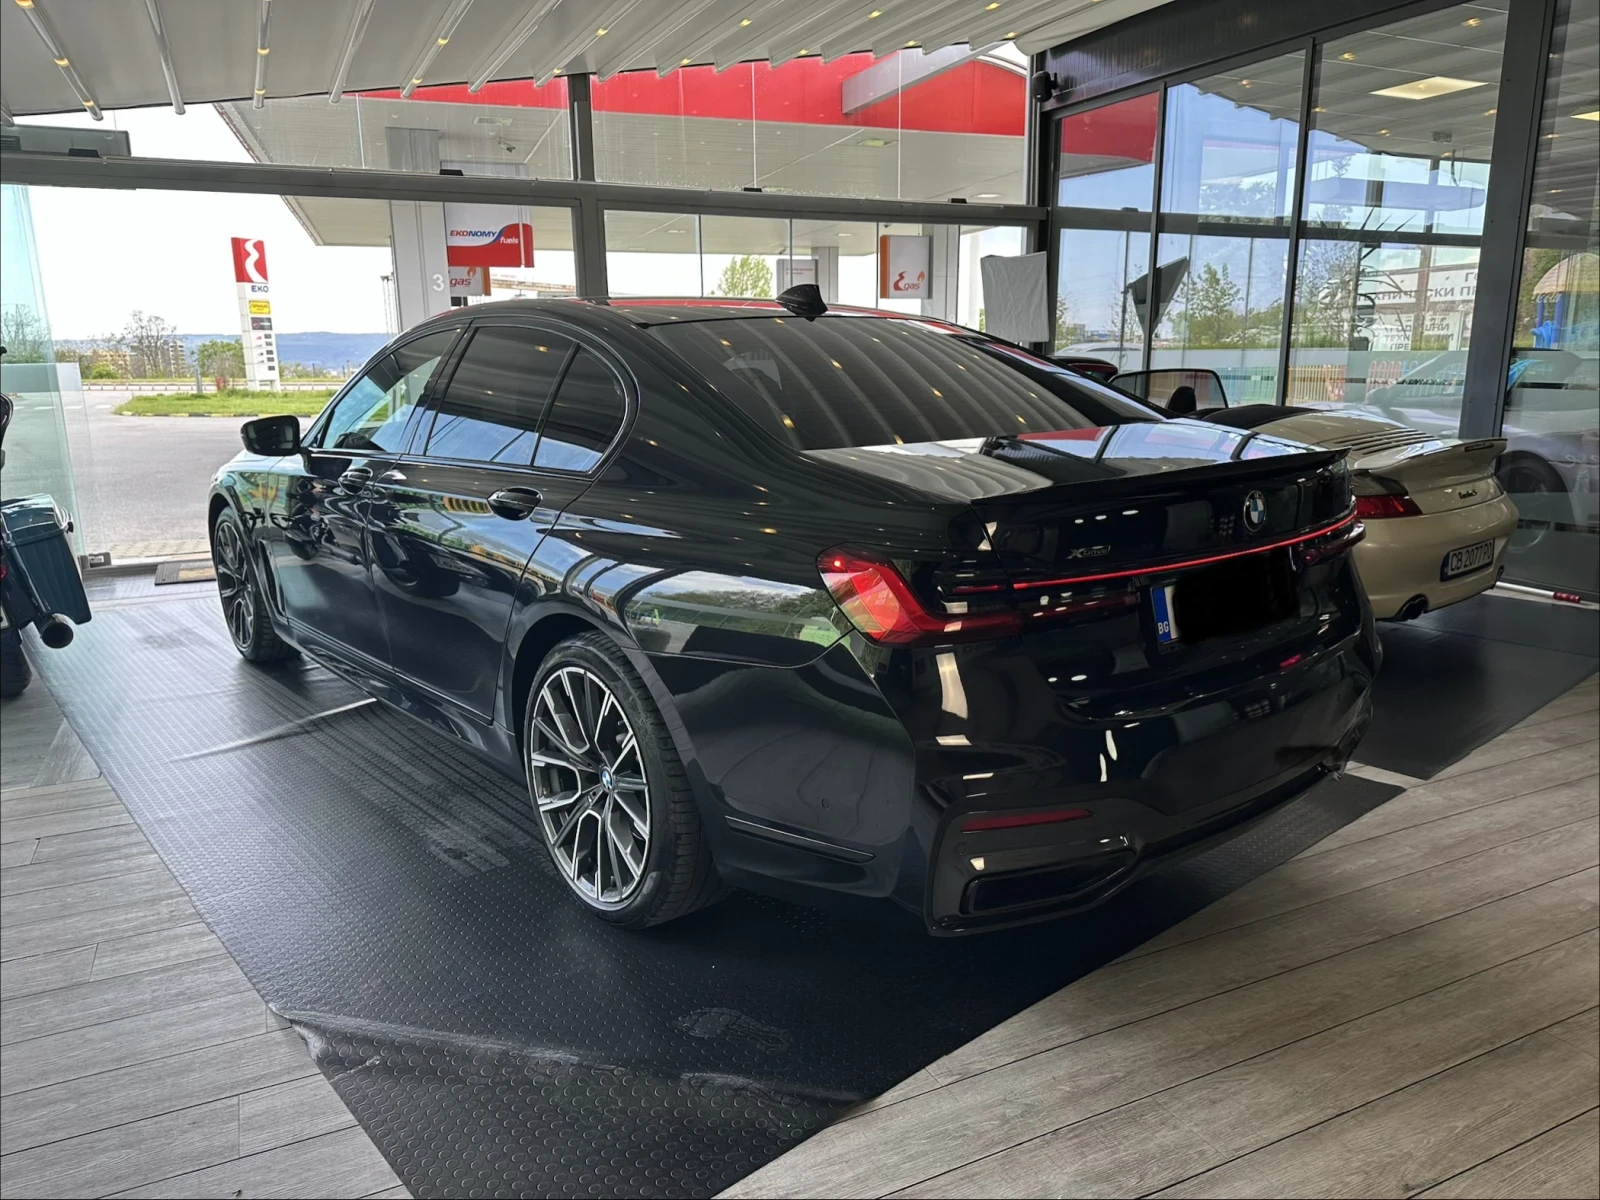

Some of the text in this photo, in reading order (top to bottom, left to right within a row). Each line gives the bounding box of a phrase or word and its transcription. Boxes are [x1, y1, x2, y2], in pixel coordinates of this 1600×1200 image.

[449, 229, 498, 238] EKONOMY
[500, 236, 519, 244] fuels
[251, 284, 269, 293] EKO
[432, 273, 445, 292] 3
[1463, 545, 1483, 568] 2077
[1157, 620, 1170, 635] BG
